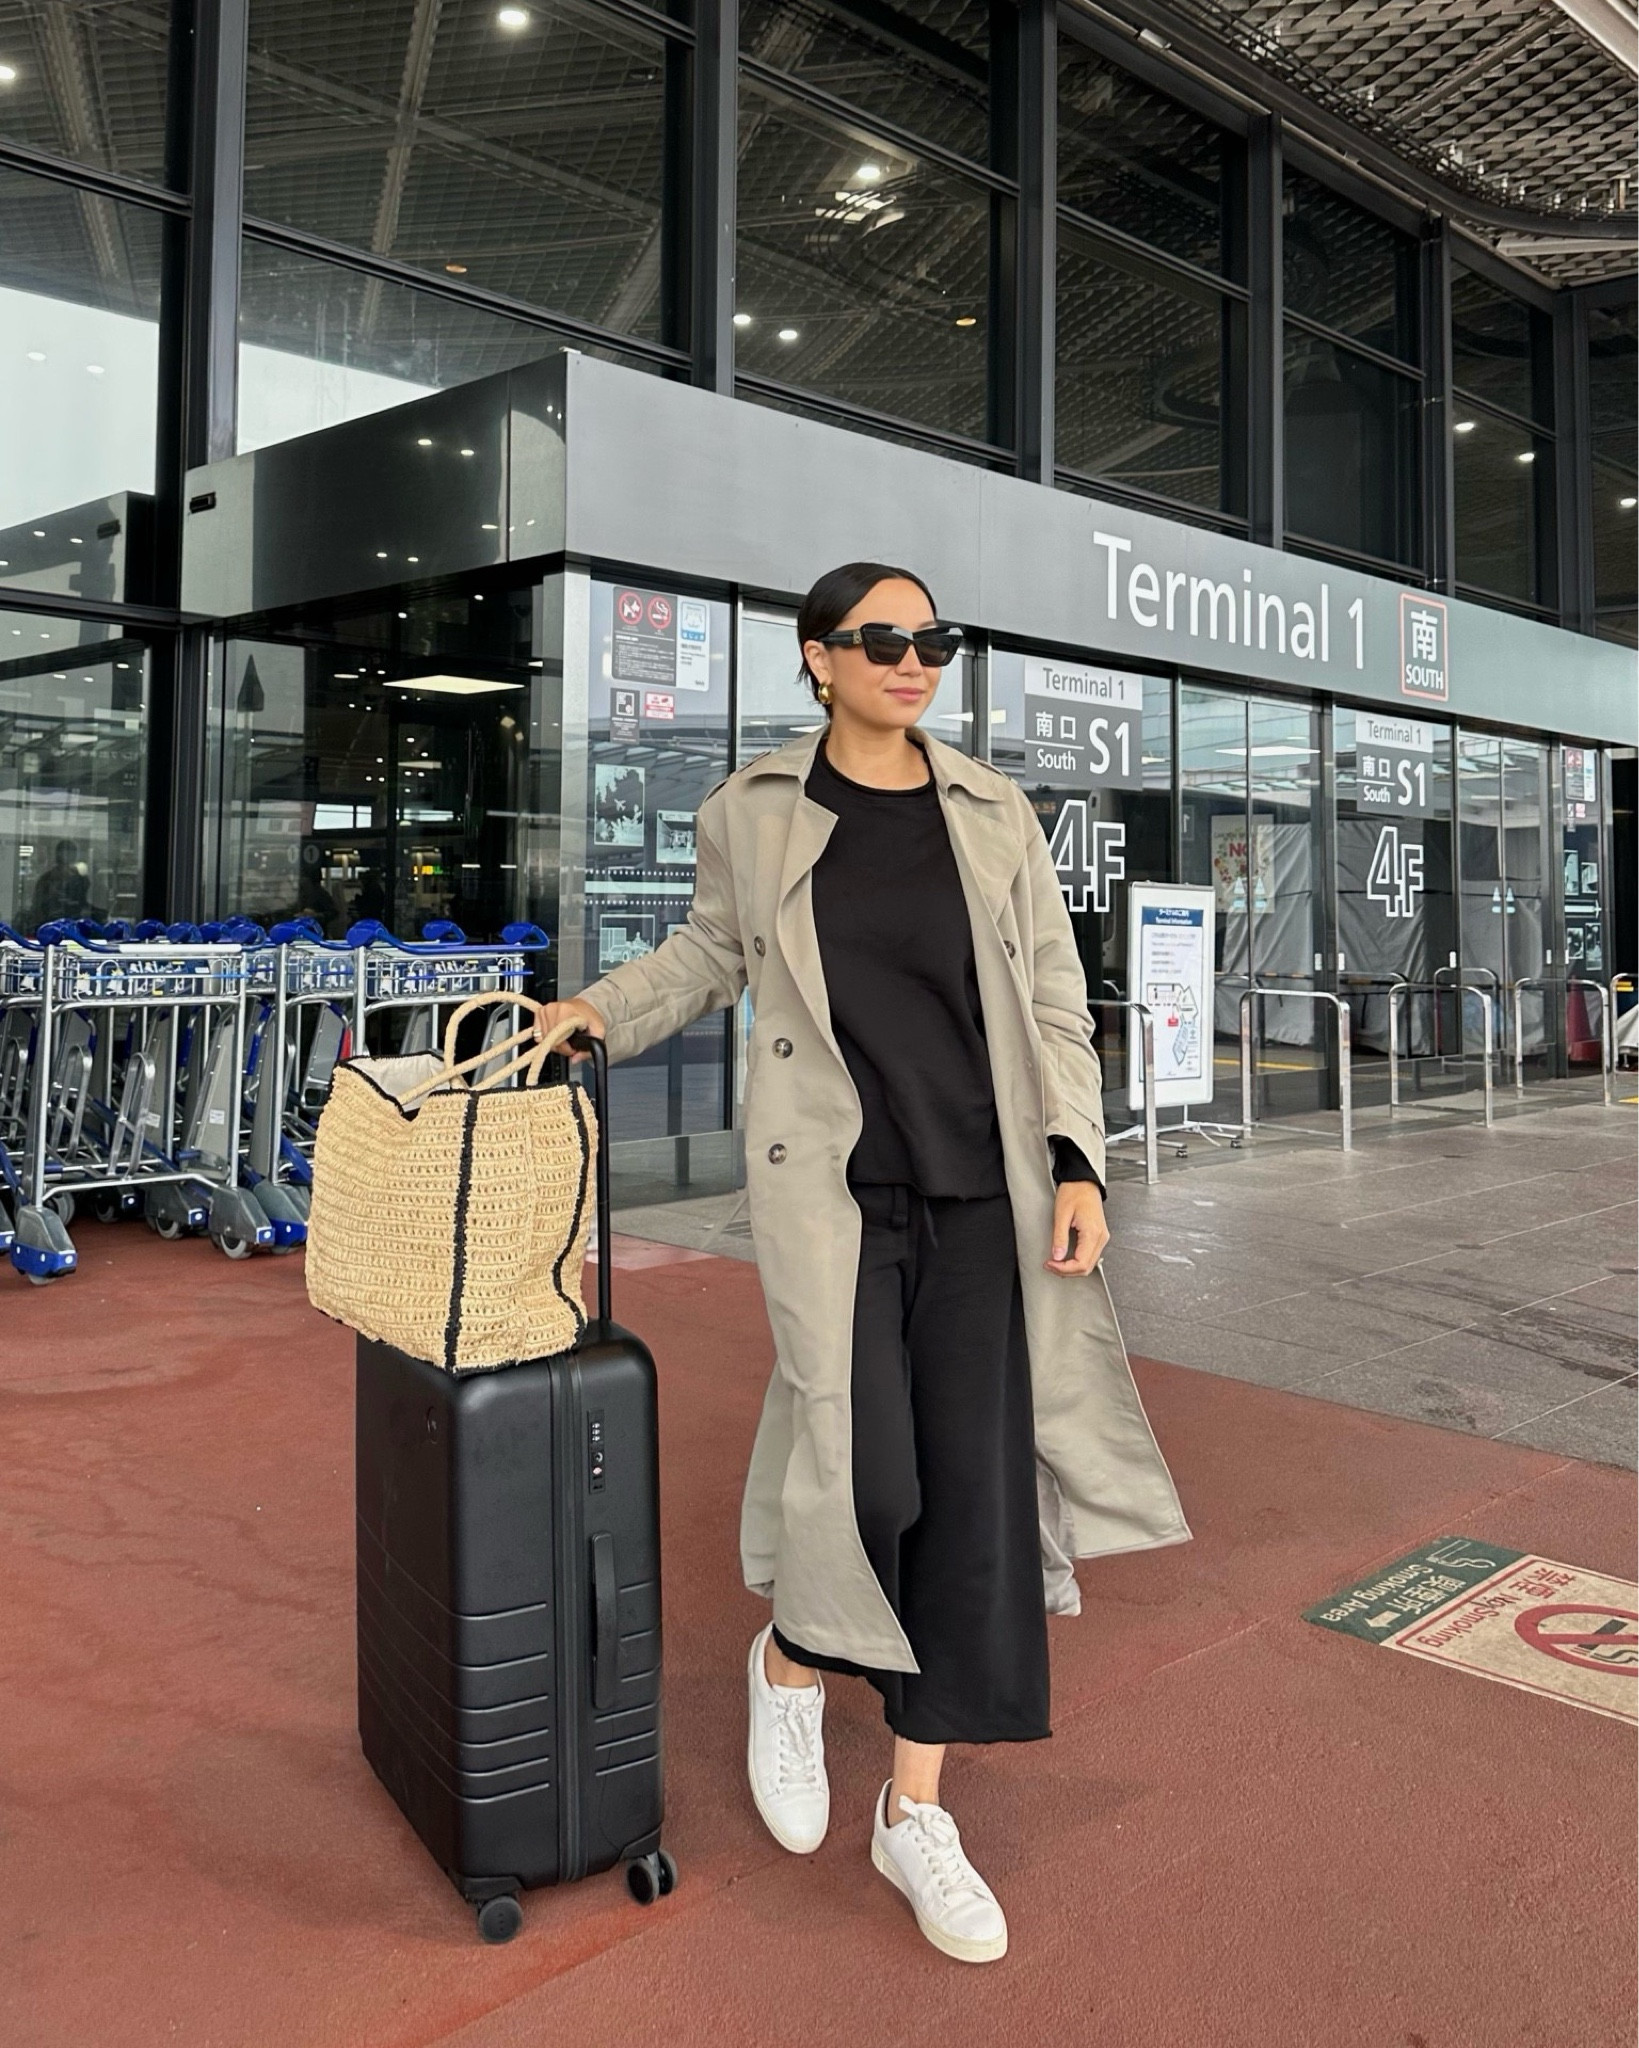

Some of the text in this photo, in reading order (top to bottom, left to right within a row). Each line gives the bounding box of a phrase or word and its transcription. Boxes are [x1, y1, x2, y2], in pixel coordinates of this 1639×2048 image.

[1093, 531, 1364, 670] Terminal 1
[1410, 609, 1438, 662] 南
[1043, 667, 1124, 700] Terminal 1
[1406, 663, 1444, 691] SOUTH
[1035, 711, 1076, 740] 南口
[1367, 719, 1422, 745] Terminal 1
[1037, 748, 1076, 771] South
[1089, 717, 1130, 777] S1
[1362, 755, 1391, 779] 南口
[1397, 759, 1426, 807] S1
[1363, 785, 1391, 804] South
[1048, 799, 1126, 913] 4F
[1367, 826, 1424, 918] 4F
[1320, 1564, 1434, 1622] Smoking Area
[1508, 1567, 1577, 1599] 禁煙
[1416, 1607, 1499, 1648] Smoking
